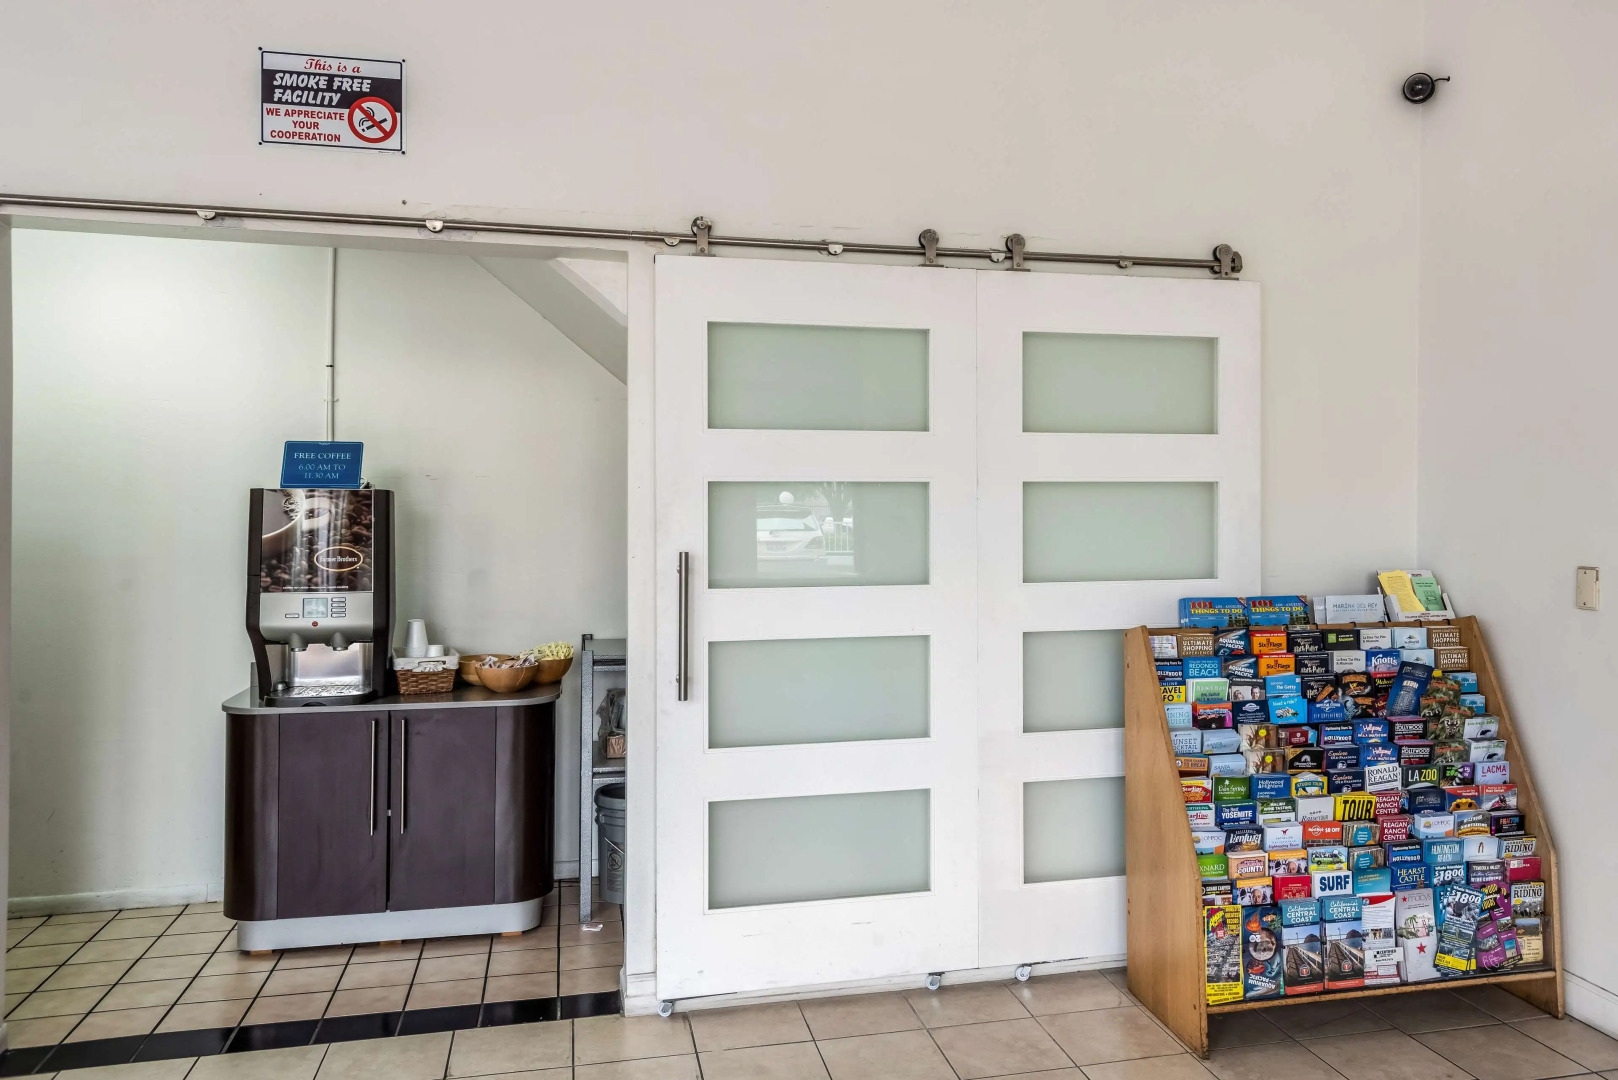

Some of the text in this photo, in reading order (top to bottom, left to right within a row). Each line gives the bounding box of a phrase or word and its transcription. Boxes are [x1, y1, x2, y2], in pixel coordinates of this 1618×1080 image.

[304, 58, 361, 74] This is a
[273, 73, 371, 92] SMOKE FREE
[273, 88, 341, 106] FACILITY
[266, 108, 345, 121] WE APPRECIATE
[292, 120, 319, 130] YOUR
[270, 130, 341, 142] COOPERATION
[1190, 601, 1213, 609] 101
[1372, 654, 1397, 666] Knott's
[1229, 665, 1254, 674] AQUARIUM
[1368, 766, 1397, 775] RONALD
[1409, 769, 1437, 781] LA ZOO
[1482, 766, 1506, 774] LACMA
[1369, 772, 1398, 783] REAGAN
[1342, 799, 1373, 820] TOUR
[1222, 811, 1252, 819] YOSEMITE
[1432, 844, 1459, 854] HUNTINGTON
[1504, 844, 1533, 853] RIDING
[1200, 864, 1225, 872] XNARD
[1238, 866, 1264, 874] COUNTY
[1398, 867, 1426, 876] HEARST
[1320, 875, 1349, 892] SURF
[1400, 874, 1424, 883] CASTLE
[1514, 888, 1542, 898] RIDING
